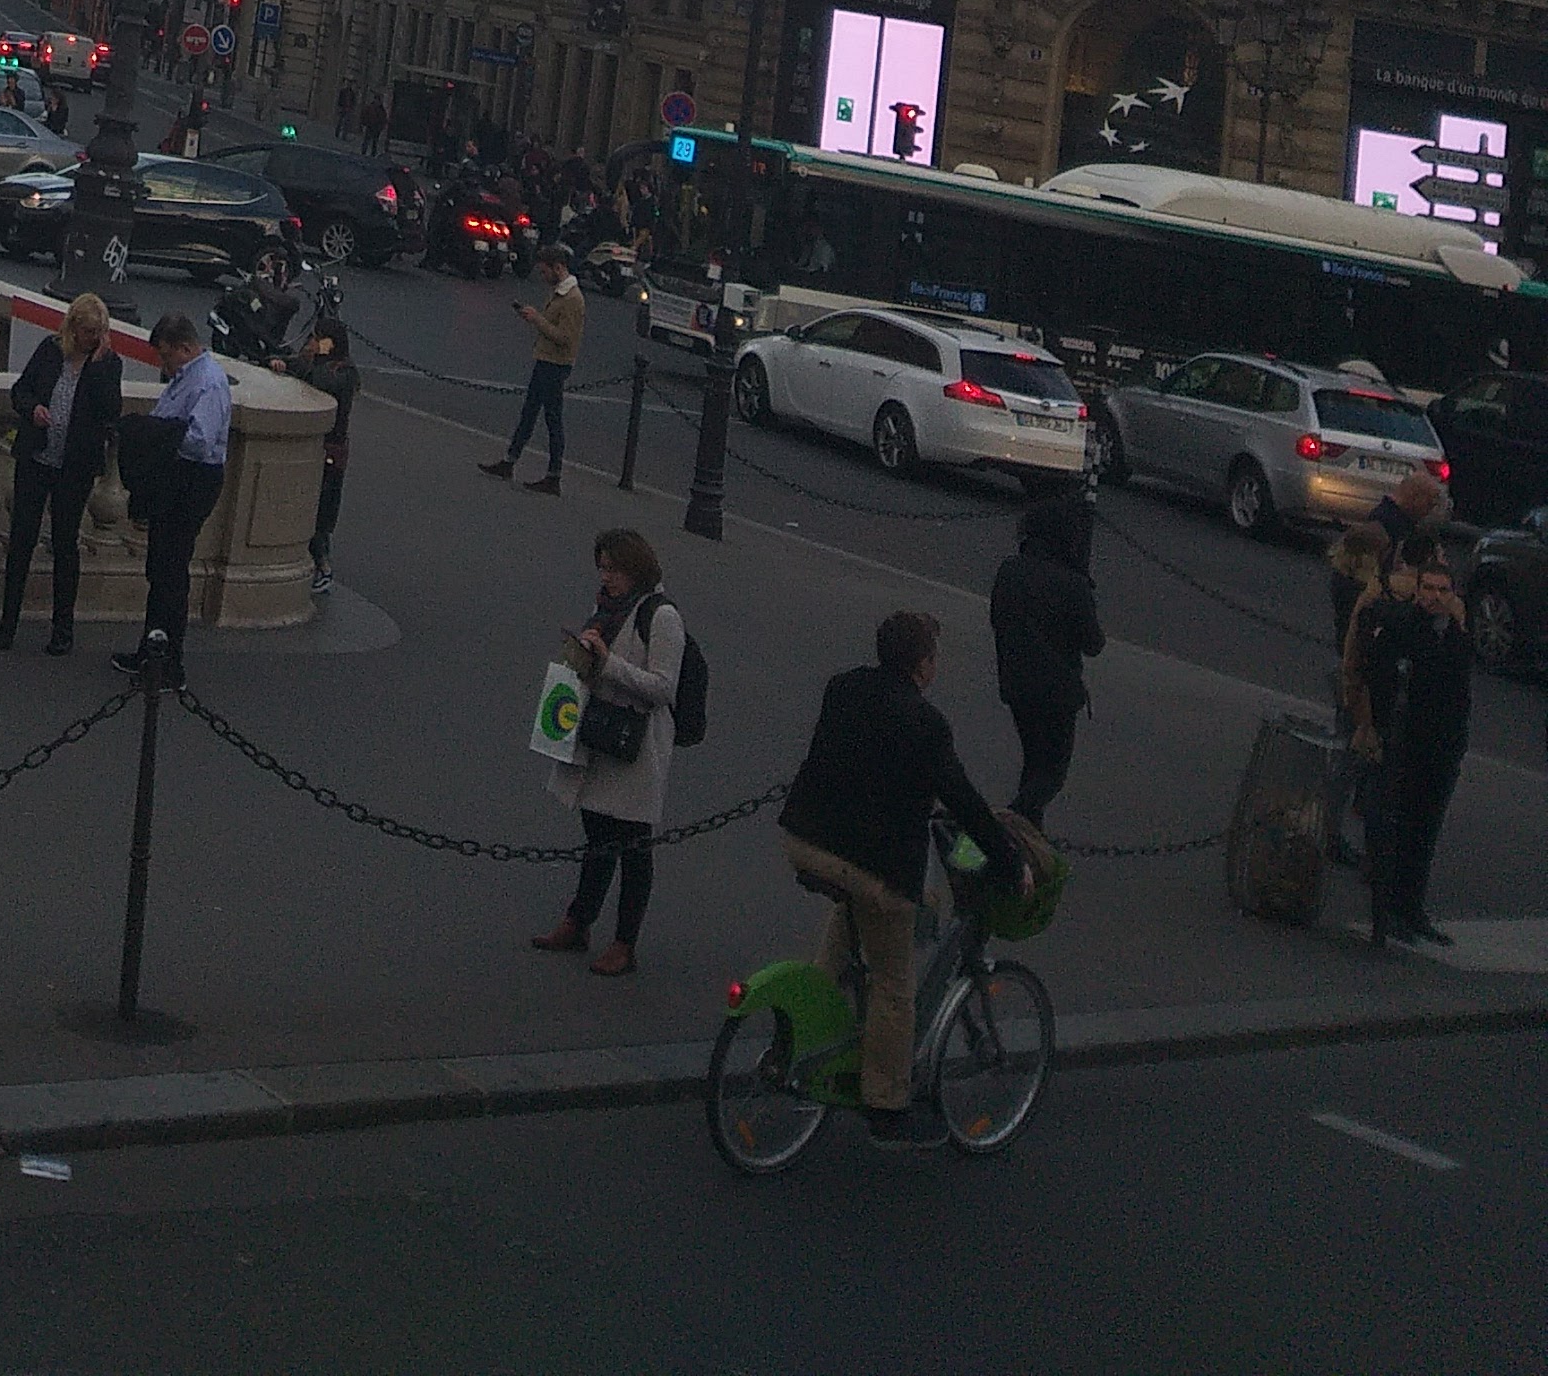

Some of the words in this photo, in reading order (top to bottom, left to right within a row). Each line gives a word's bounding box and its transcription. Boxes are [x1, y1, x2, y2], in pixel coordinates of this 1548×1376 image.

[1376, 68, 1390, 83] La
[1396, 70, 1445, 92] banque
[1478, 86, 1518, 102] monde
[676, 141, 692, 158] 29
